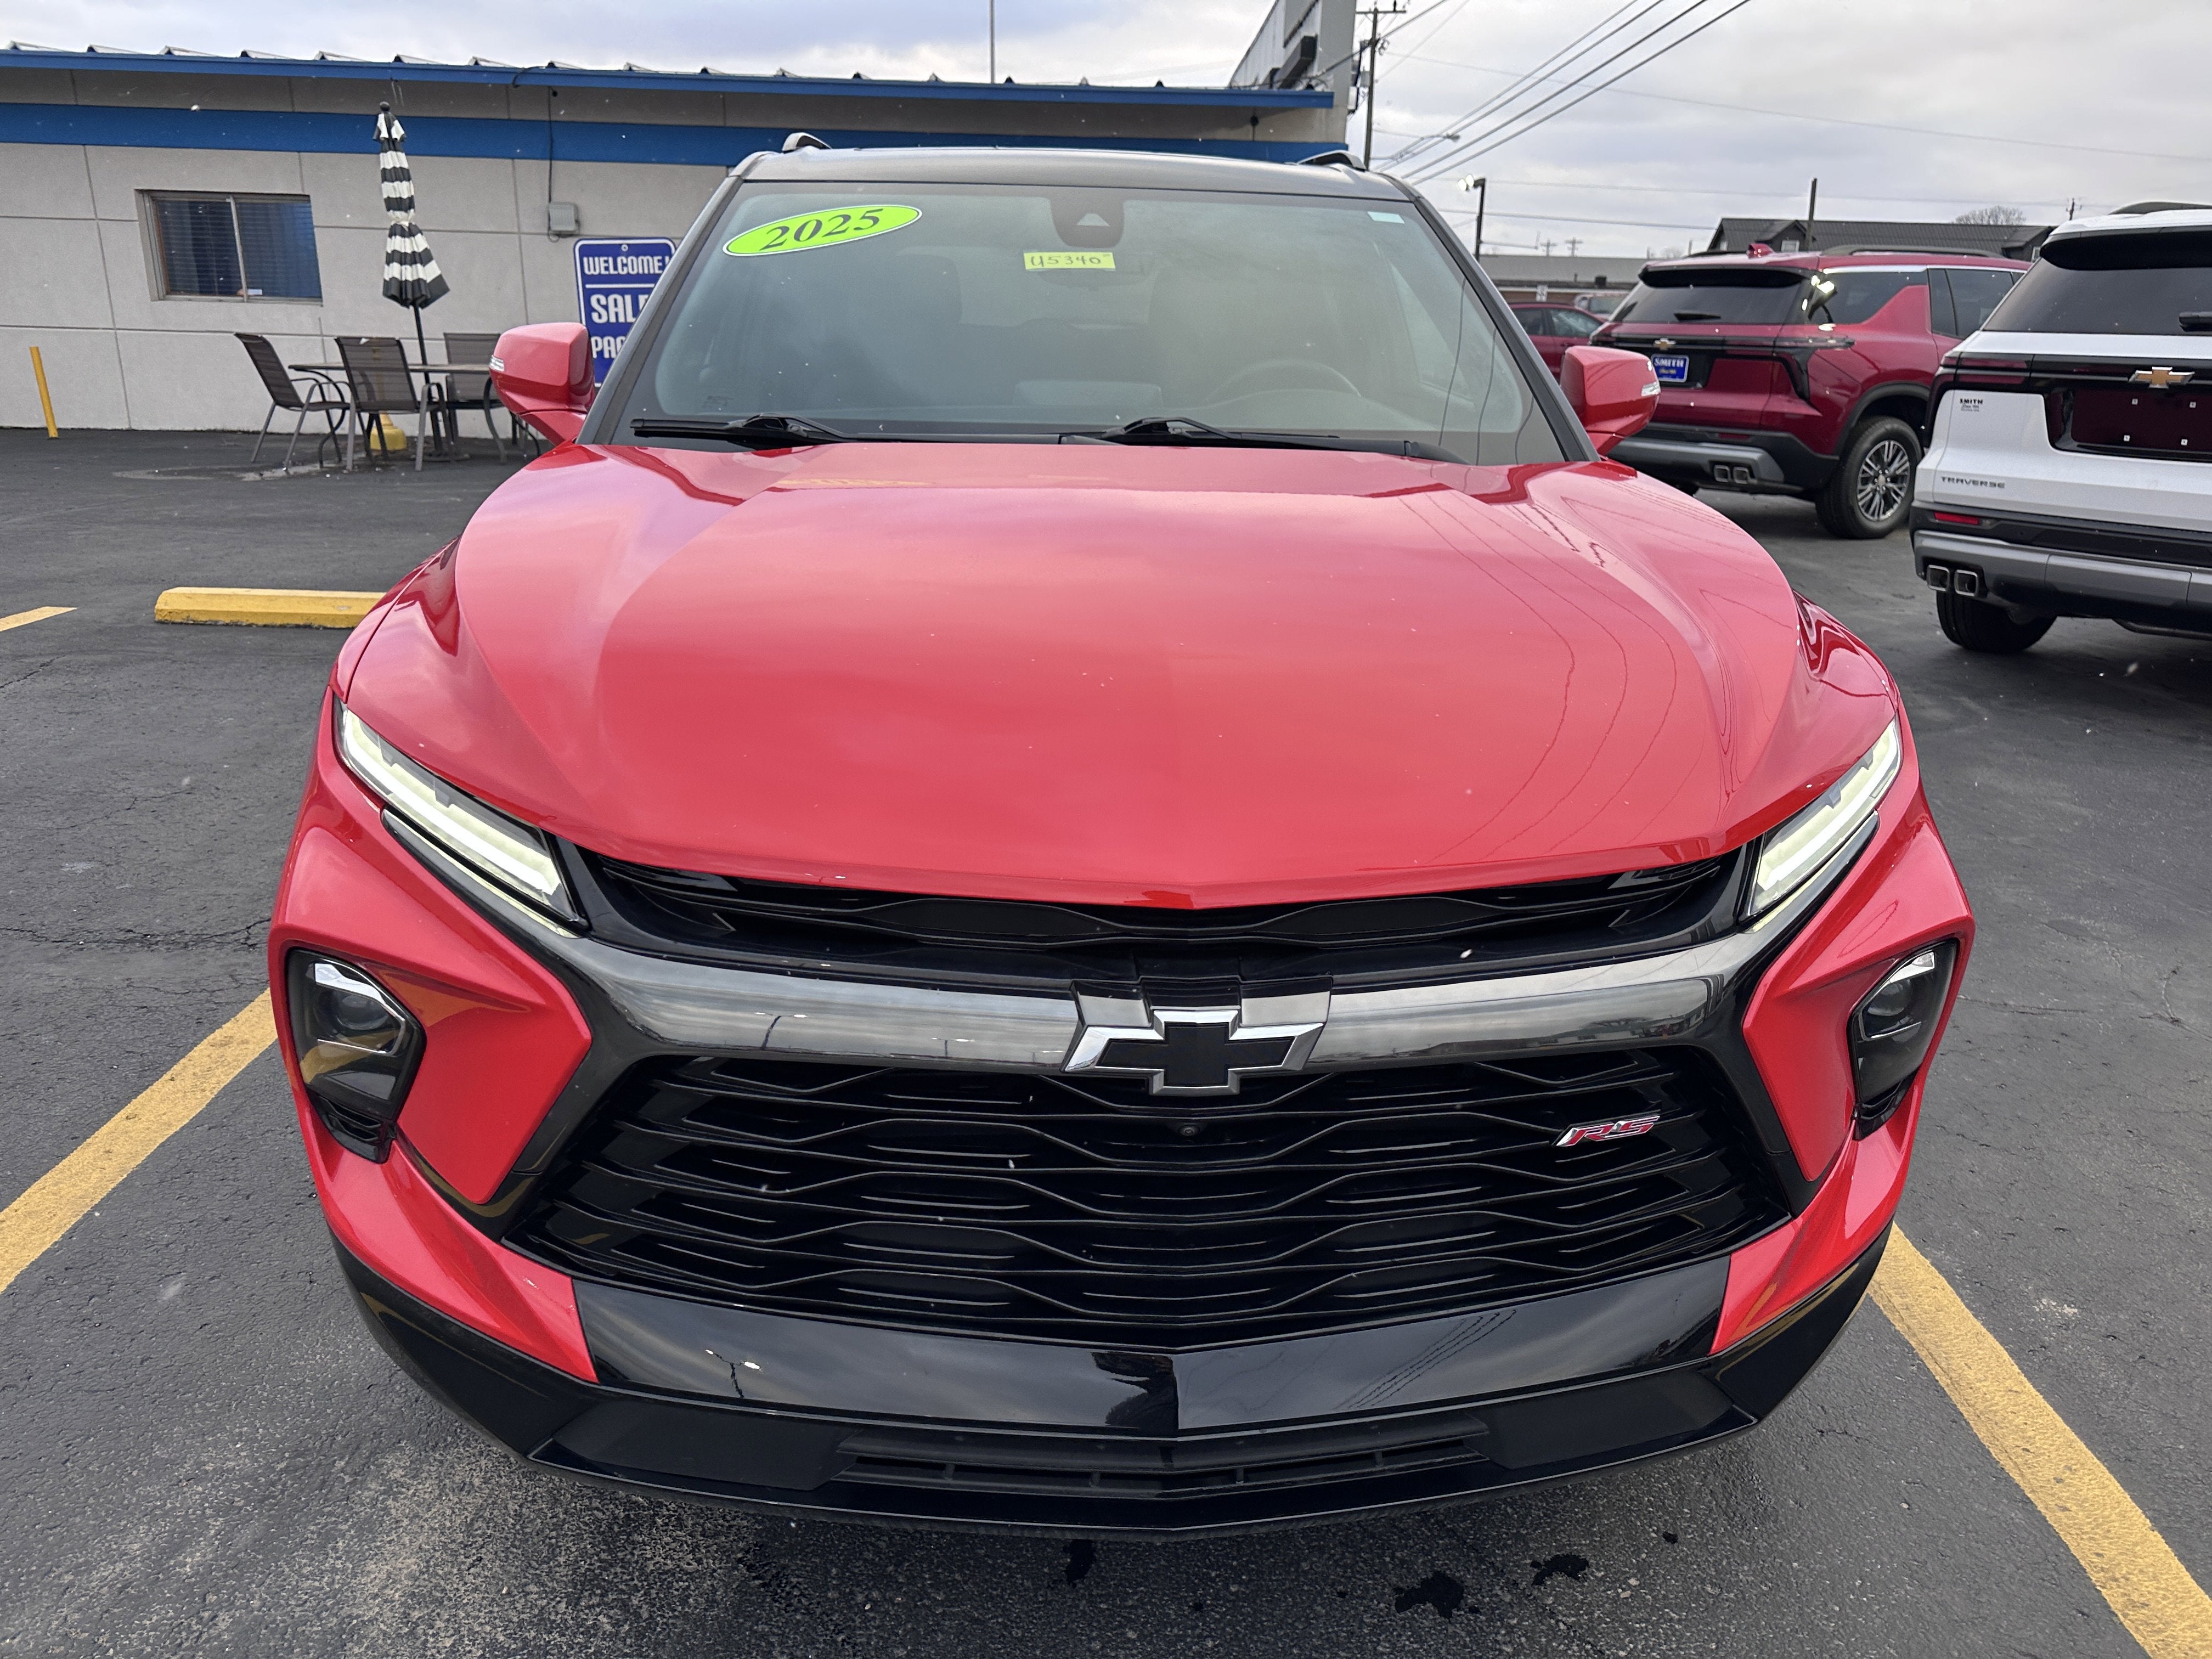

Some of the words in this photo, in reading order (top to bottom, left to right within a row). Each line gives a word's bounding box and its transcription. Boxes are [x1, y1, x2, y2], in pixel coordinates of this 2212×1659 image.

[759, 208, 883, 251] 2025
[1941, 476, 2005, 488] TRAVERSE
[1556, 1115, 1661, 1147] RS
